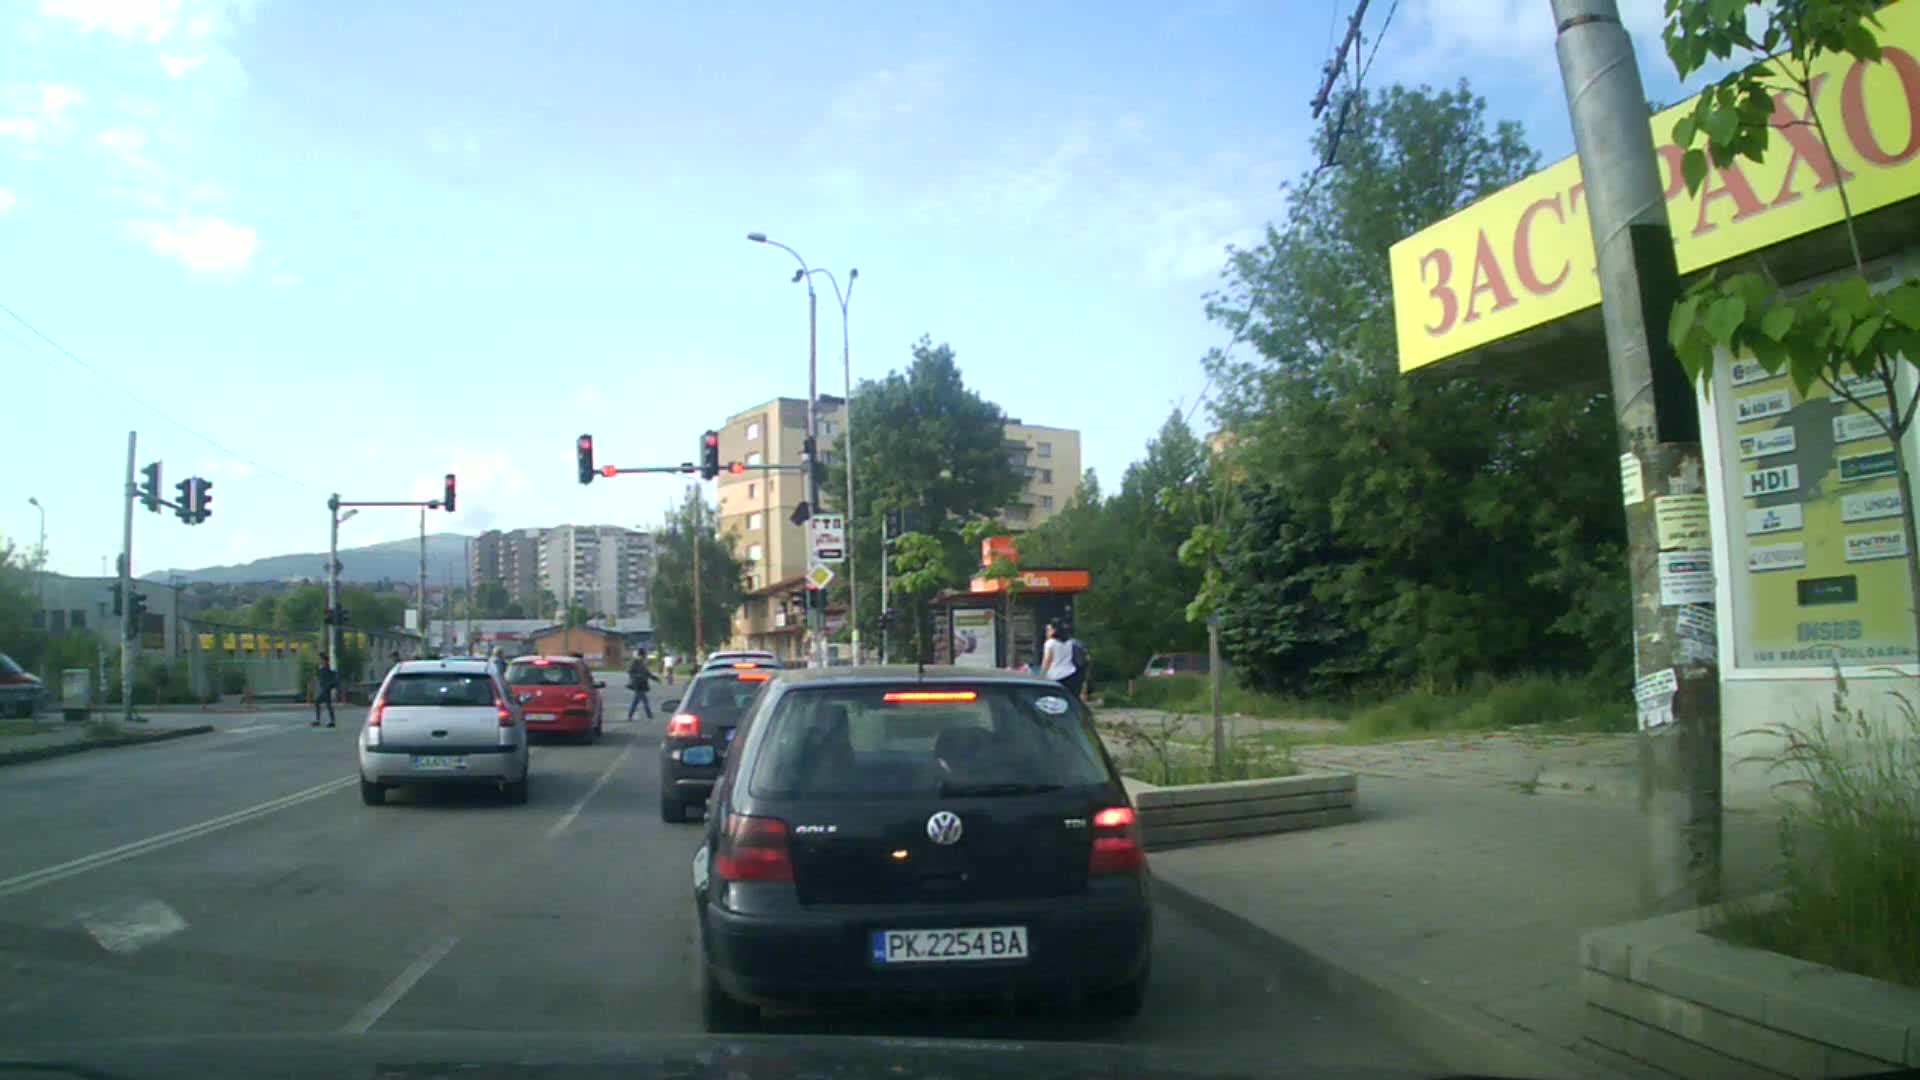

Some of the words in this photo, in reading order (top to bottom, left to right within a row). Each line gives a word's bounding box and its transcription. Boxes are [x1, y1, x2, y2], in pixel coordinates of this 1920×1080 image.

[1751, 469, 1789, 492] HDI
[927, 931, 985, 957] 2254
[991, 929, 1023, 955] BA
